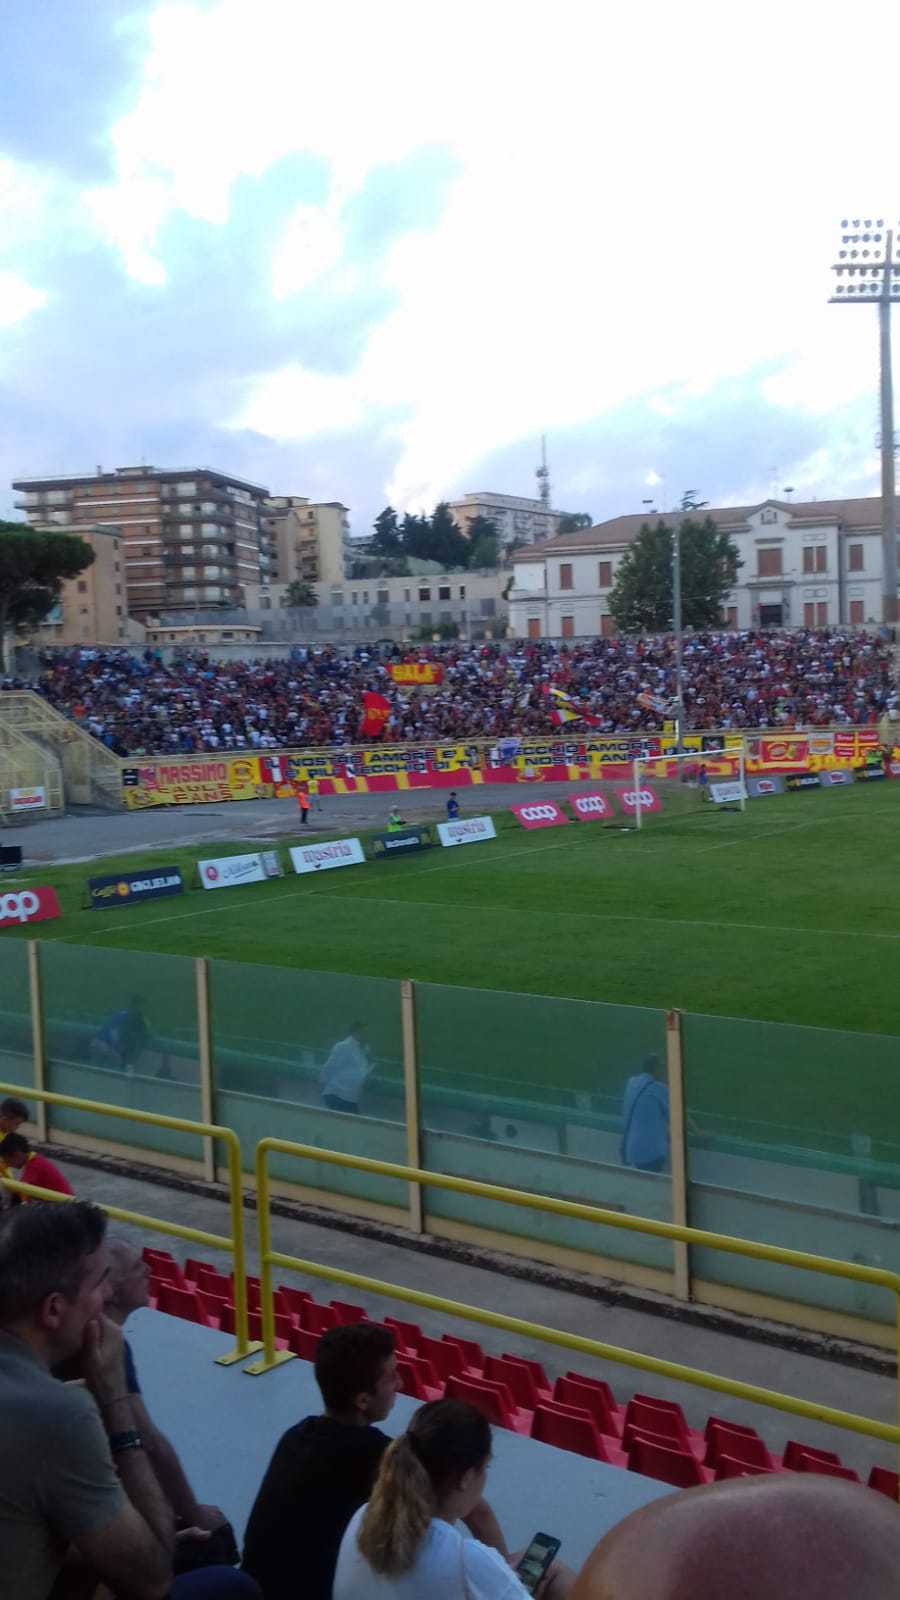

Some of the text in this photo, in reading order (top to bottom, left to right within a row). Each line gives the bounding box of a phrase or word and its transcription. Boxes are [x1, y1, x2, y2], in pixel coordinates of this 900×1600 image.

[369, 749, 435, 763] AMORE
[587, 740, 656, 752] AMORE
[158, 763, 227, 785] MASSIMO
[520, 803, 558, 821] coop
[576, 795, 605, 814] coop
